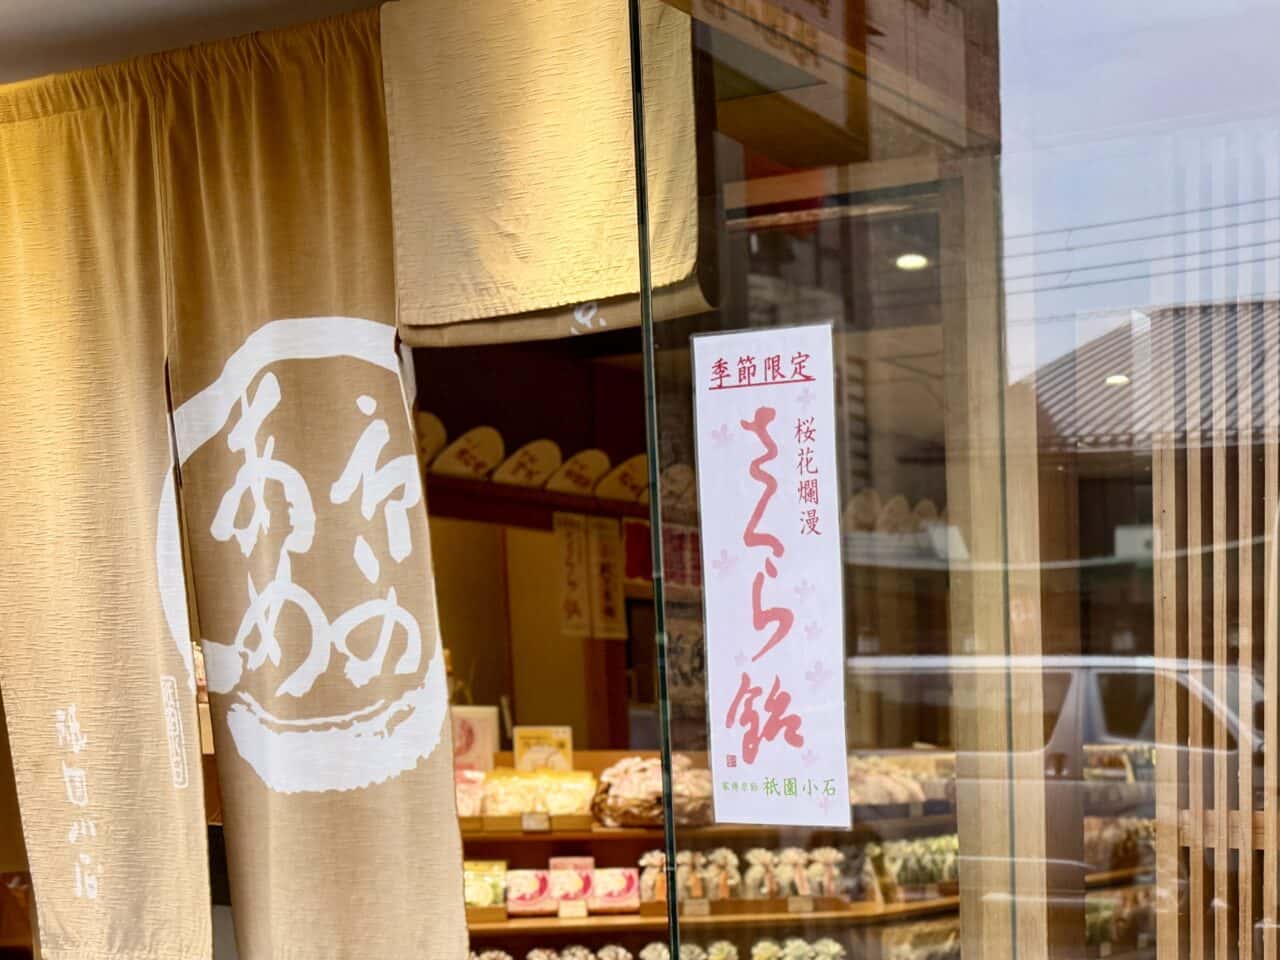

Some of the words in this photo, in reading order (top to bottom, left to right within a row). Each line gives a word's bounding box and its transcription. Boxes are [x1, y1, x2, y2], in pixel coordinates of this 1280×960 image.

[709, 351, 814, 388] 季節限定
[795, 416, 822, 536] 桜花爛漫
[210, 371, 331, 697] あめ
[725, 405, 806, 765] さくら飴
